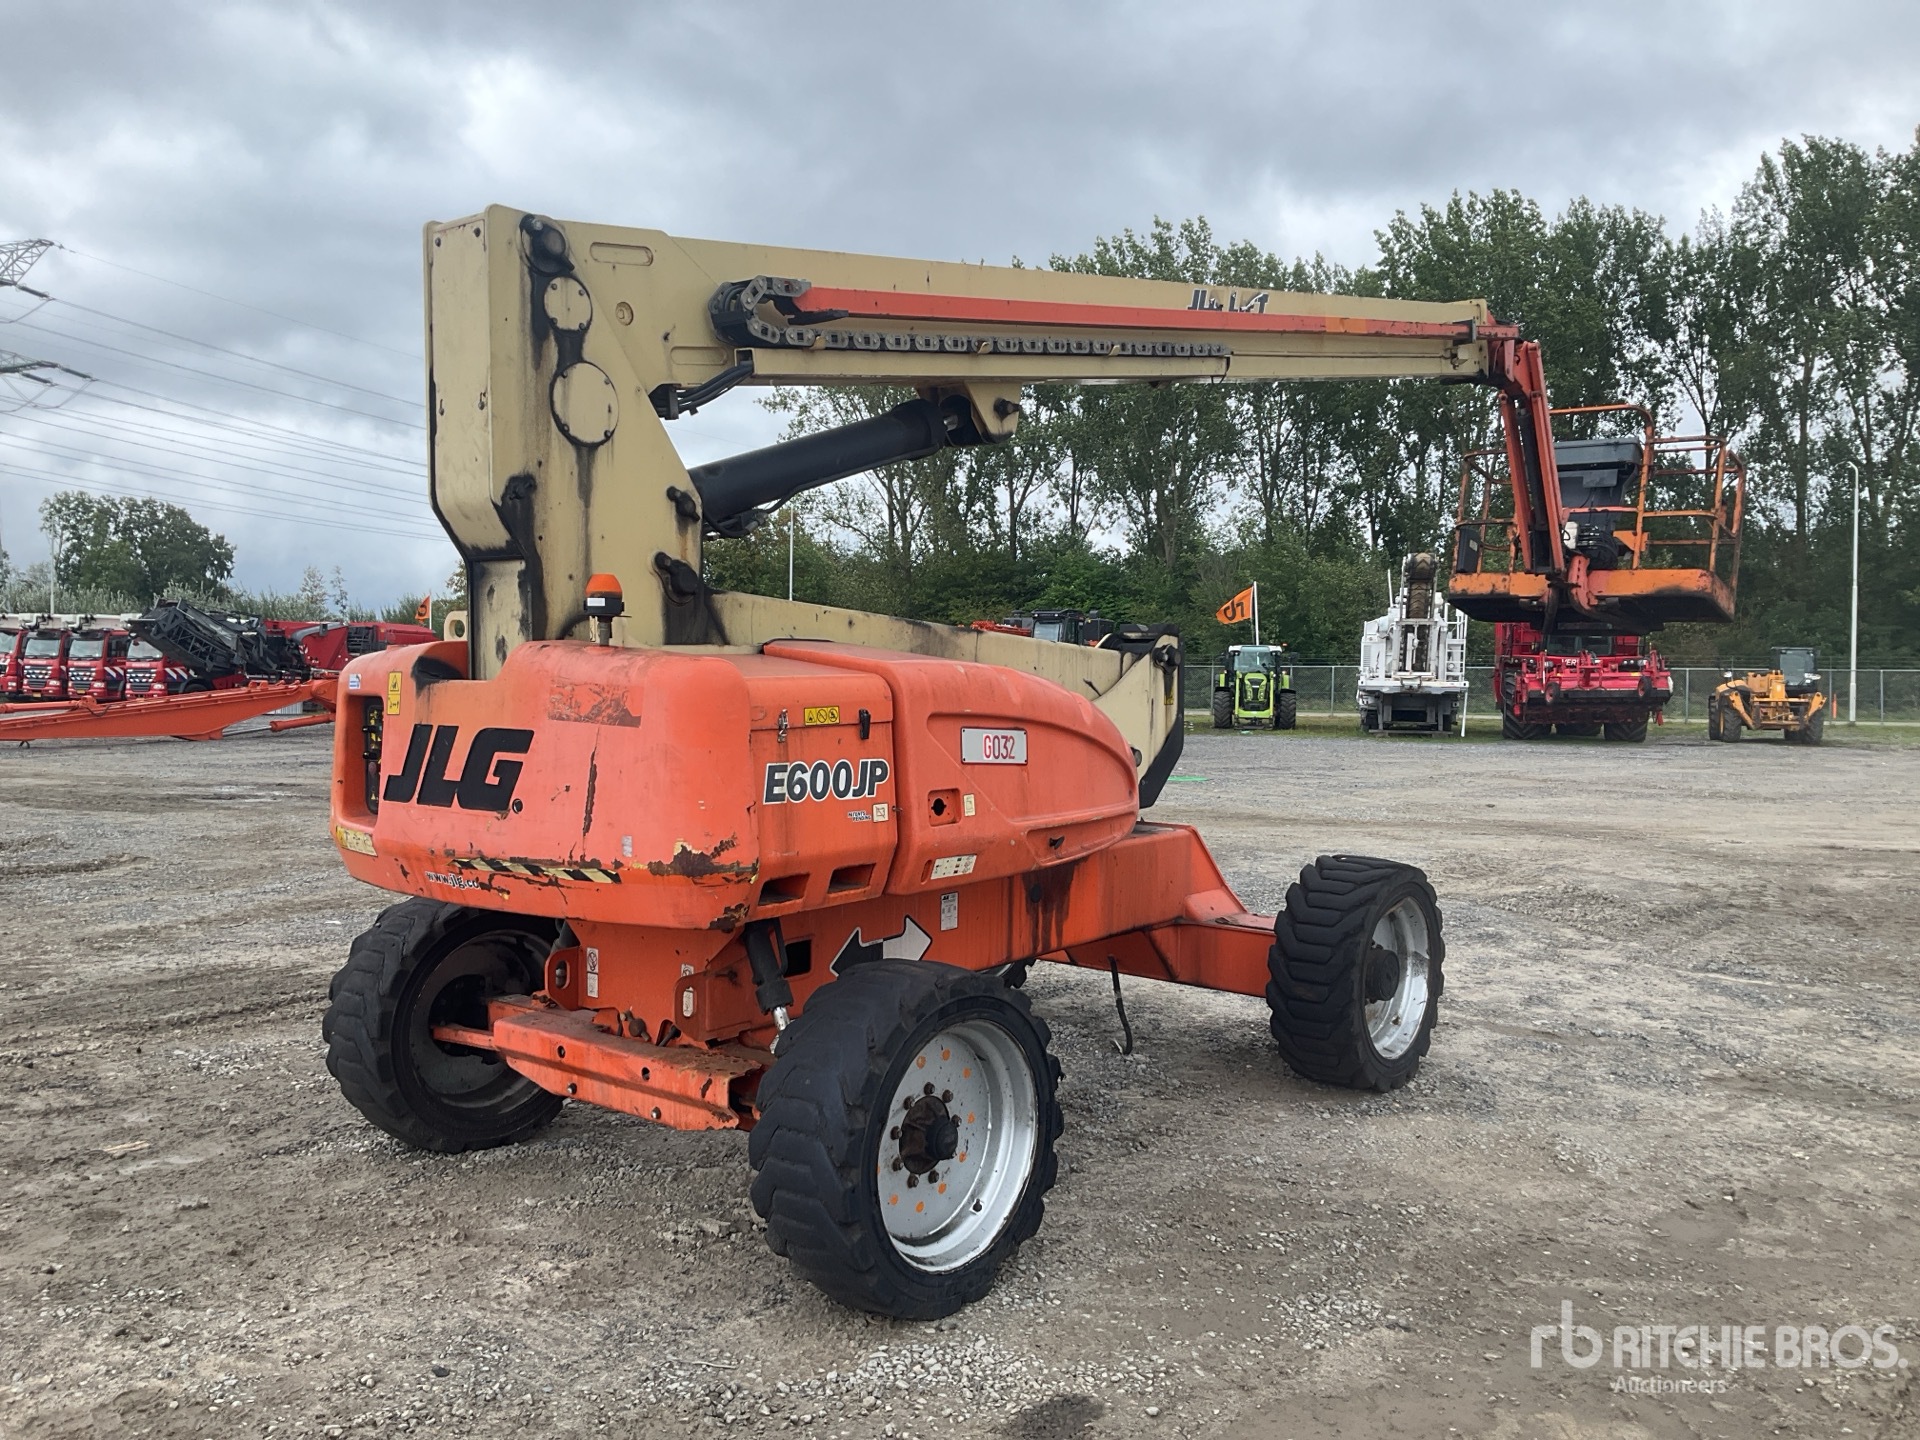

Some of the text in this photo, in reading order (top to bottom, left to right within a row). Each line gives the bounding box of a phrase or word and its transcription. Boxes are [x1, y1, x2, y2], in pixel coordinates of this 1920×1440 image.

[983, 734, 1016, 760] G032
[383, 724, 534, 811] JLG
[763, 759, 889, 804] E600JP
[425, 871, 481, 890] www.jlg.co
